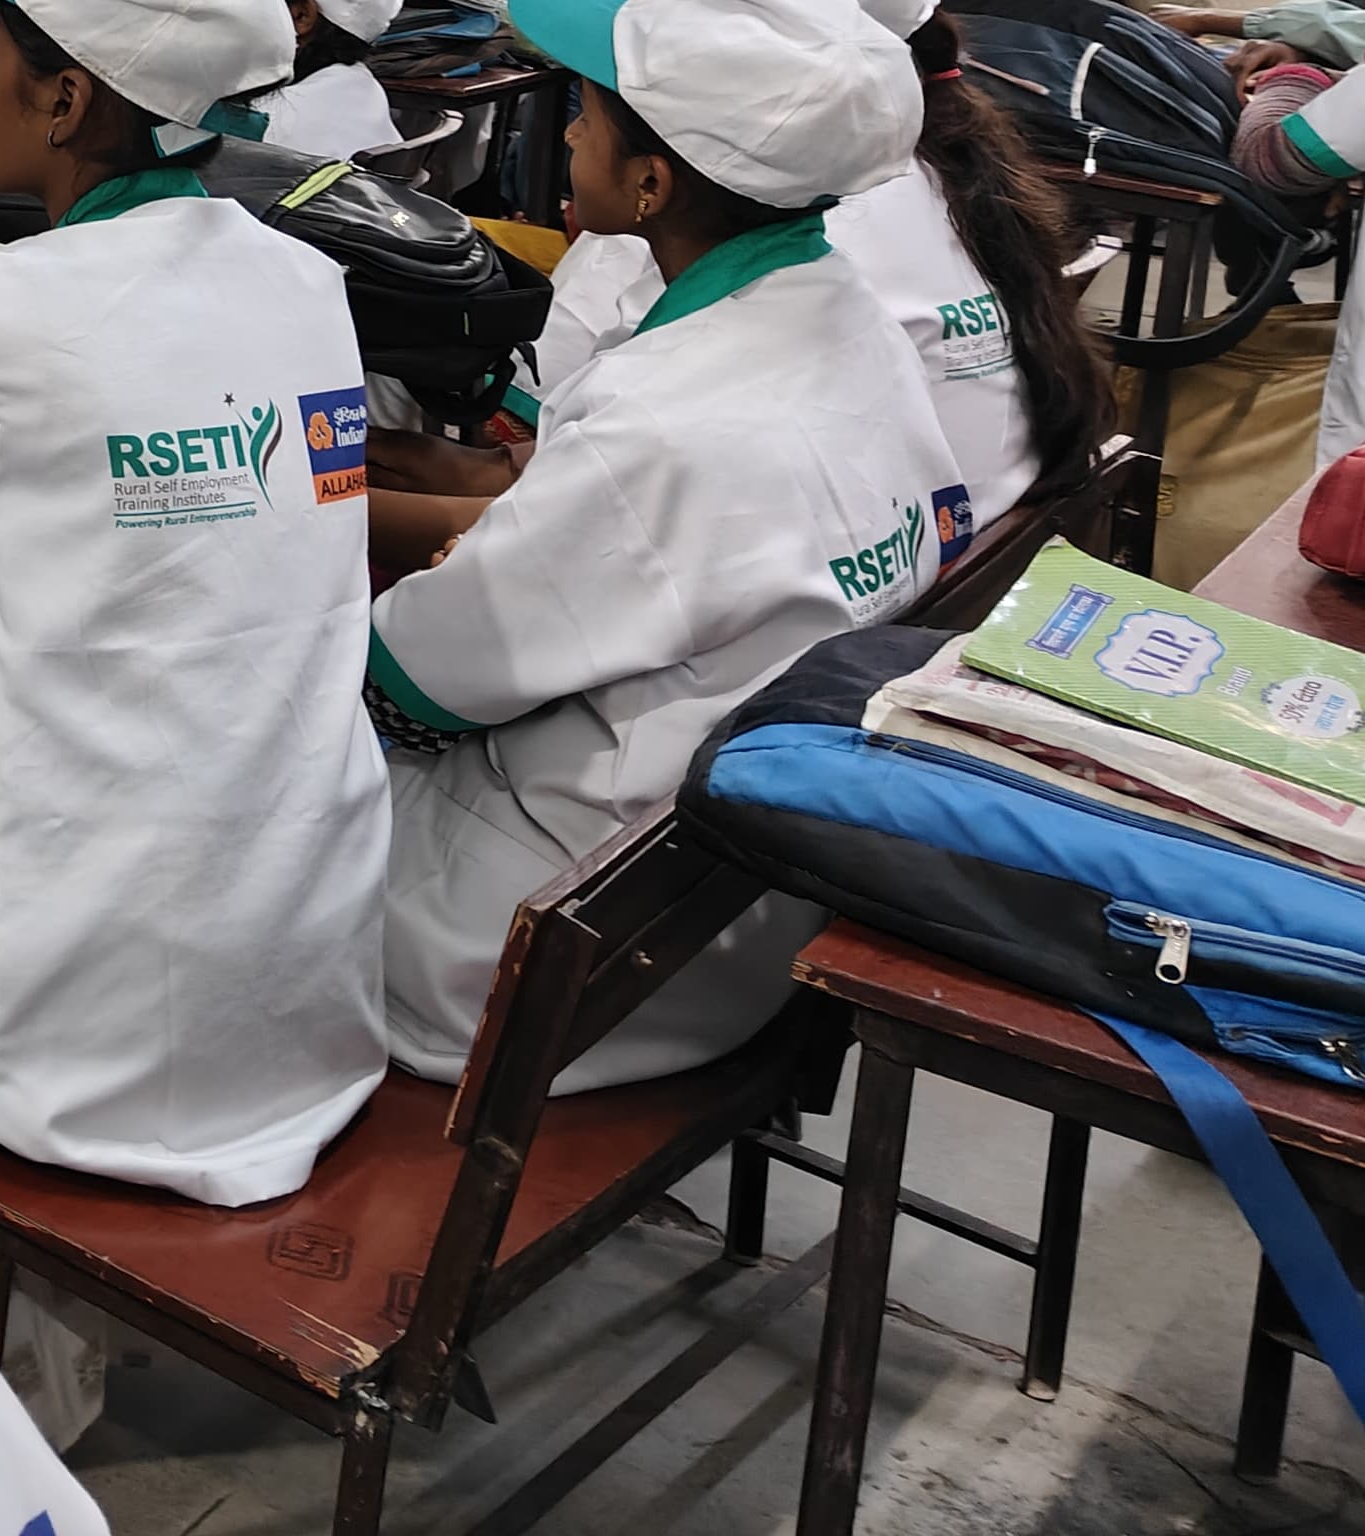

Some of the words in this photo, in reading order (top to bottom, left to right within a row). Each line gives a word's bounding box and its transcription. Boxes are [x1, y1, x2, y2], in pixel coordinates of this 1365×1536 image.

[106, 424, 248, 479] RSETI
[114, 480, 151, 496] Rural
[155, 477, 177, 494] Self
[180, 471, 249, 493] Employment
[115, 494, 169, 512] Training
[172, 490, 227, 507] Institutes
[115, 517, 162, 530] Powering
[164, 513, 187, 526] Rural
[828, 526, 909, 601] RSETI
[1123, 628, 1203, 681] V.I.P.
[1218, 664, 1254, 697] Brand
